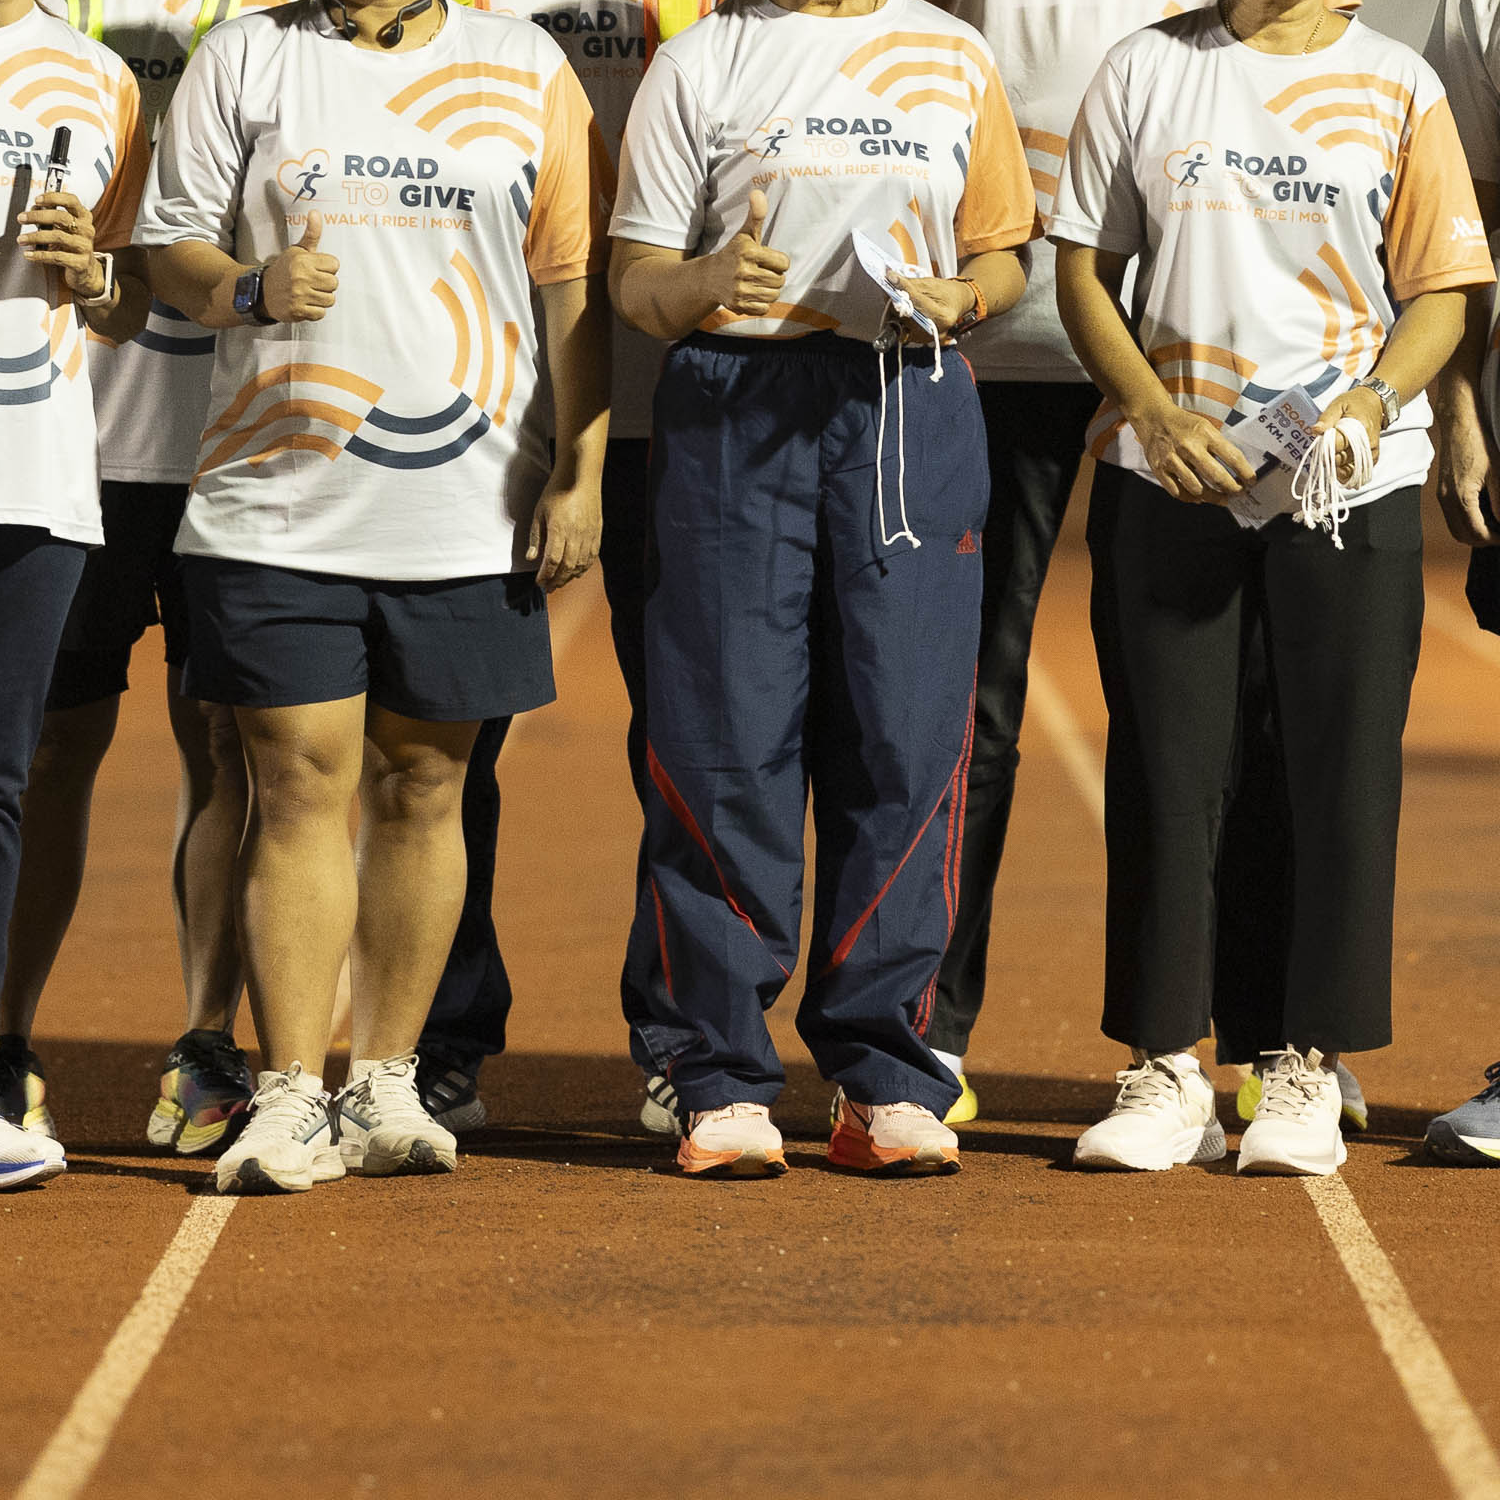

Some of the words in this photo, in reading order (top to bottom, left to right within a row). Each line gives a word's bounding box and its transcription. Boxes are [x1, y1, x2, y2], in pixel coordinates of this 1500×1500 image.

[126, 56, 185, 81] ROA
[805, 117, 892, 135] ROAD
[859, 139, 930, 162] GIVE
[1225, 149, 1307, 176] ROAD
[344, 154, 439, 180] ROAD
[752, 170, 779, 187] RUN
[789, 164, 832, 178] WALK
[844, 164, 879, 176] RIDE
[892, 164, 930, 180] MOVE
[342, 180, 389, 206] TO
[400, 184, 476, 211] GIVE
[1272, 180, 1341, 208] GIVE
[324, 213, 371, 226] WALK
[381, 215, 419, 228] RIDE
[430, 216, 473, 232] MOVE
[1168, 200, 1193, 213] RUN
[1254, 208, 1287, 221] RIDE
[1299, 211, 1330, 224] MOV
